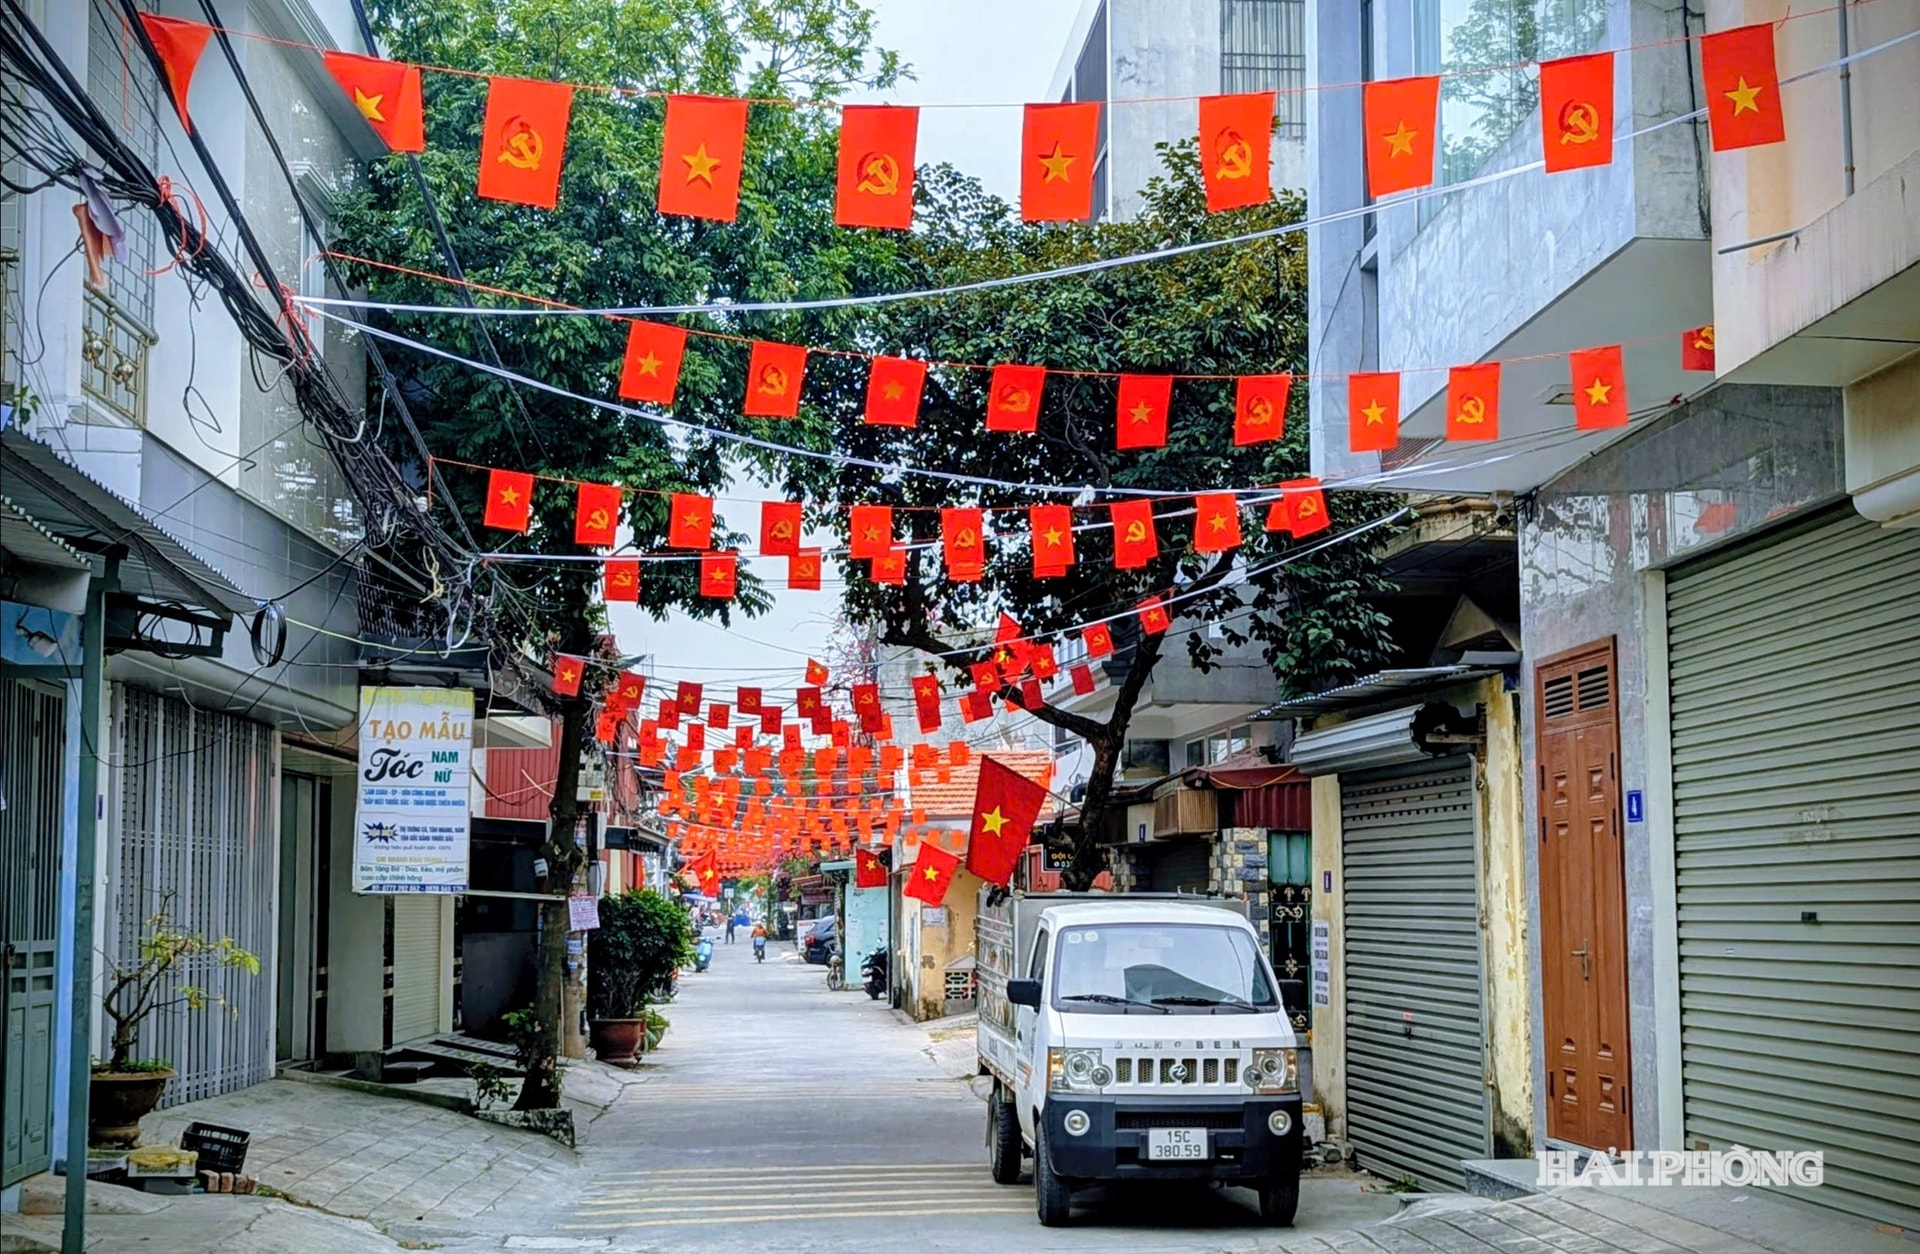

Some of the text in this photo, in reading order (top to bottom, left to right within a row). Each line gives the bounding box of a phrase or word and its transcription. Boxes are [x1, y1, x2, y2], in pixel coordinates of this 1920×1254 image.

[369, 711, 466, 745] TẠO MẪU
[431, 751, 459, 763] NAM
[364, 748, 424, 782] Tóc
[434, 768, 452, 783] NỮ
[1167, 1130, 1191, 1143] 15C
[1155, 1144, 1201, 1157] 380.59
